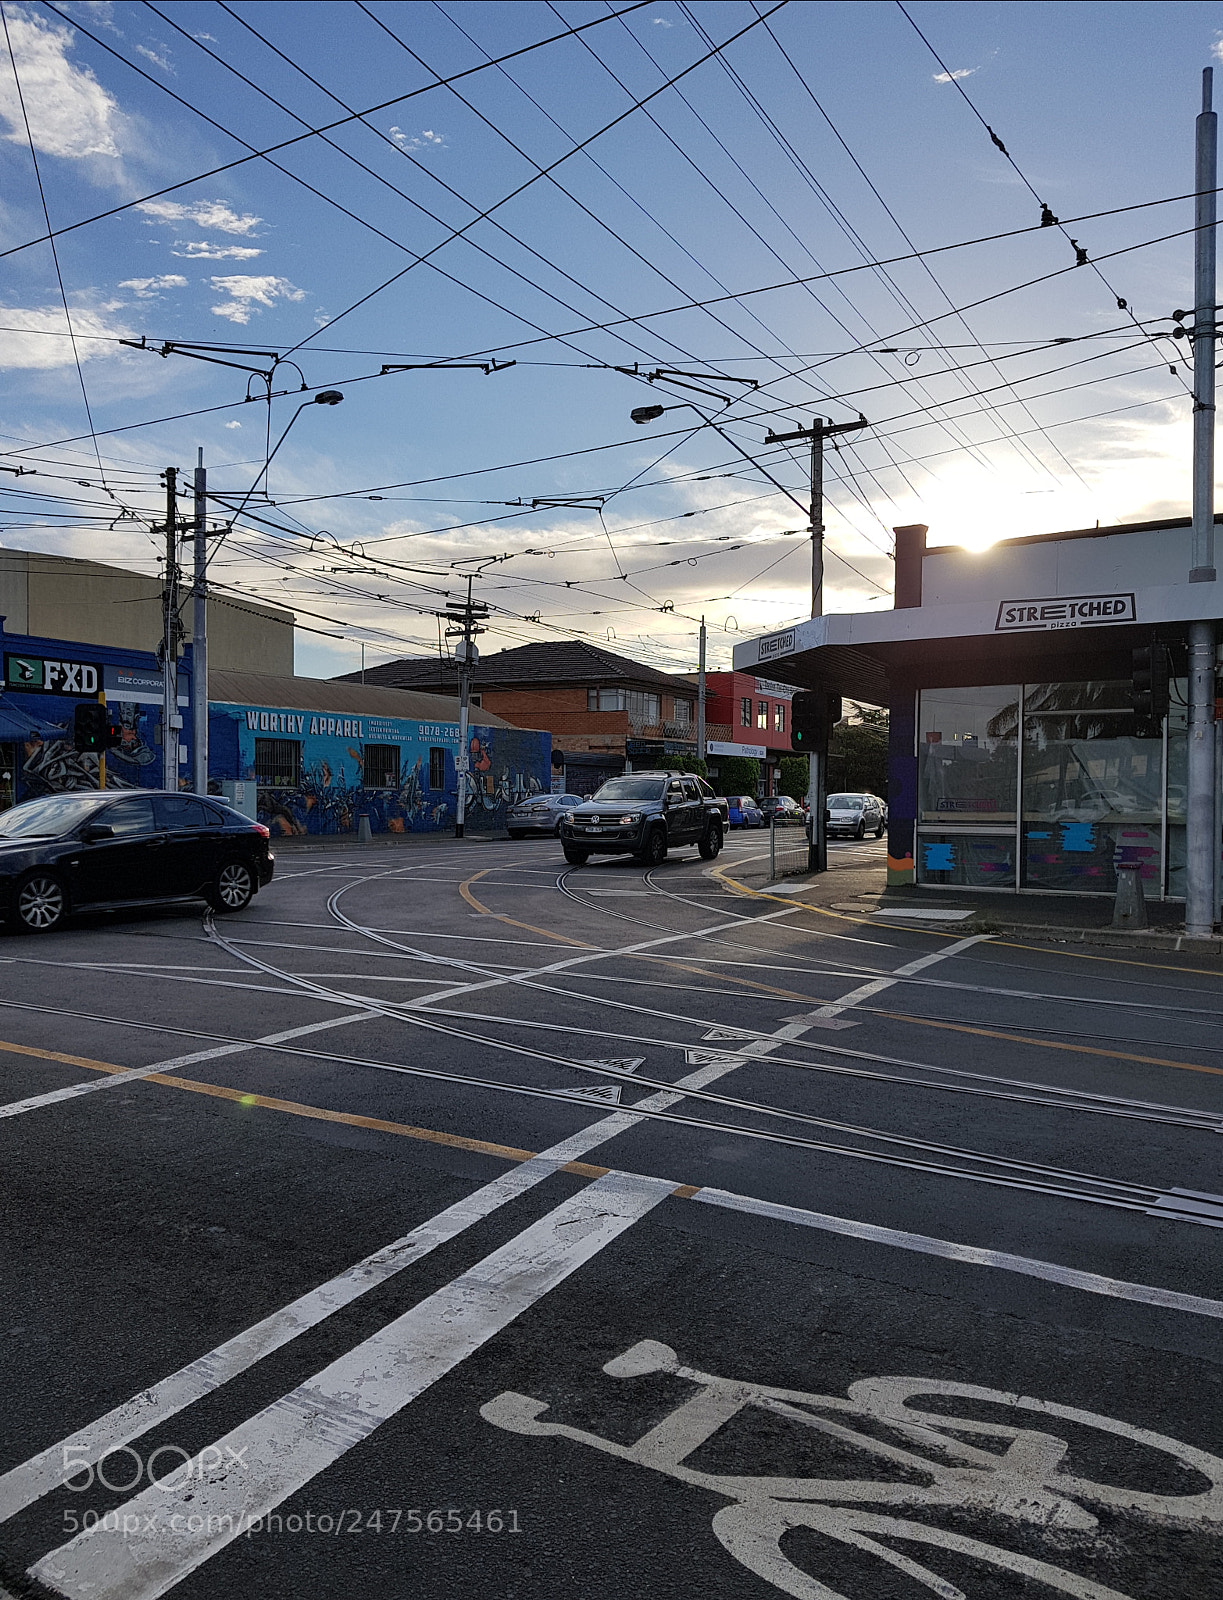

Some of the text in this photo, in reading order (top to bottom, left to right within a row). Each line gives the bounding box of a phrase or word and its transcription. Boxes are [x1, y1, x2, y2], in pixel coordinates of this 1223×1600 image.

[1005, 600, 1126, 623] STRETCHED
[1050, 620, 1077, 629] pizza
[761, 634, 793, 655] STRETCHED
[117, 676, 133, 684] BIZ
[246, 711, 364, 738] WORTHY APPAREL
